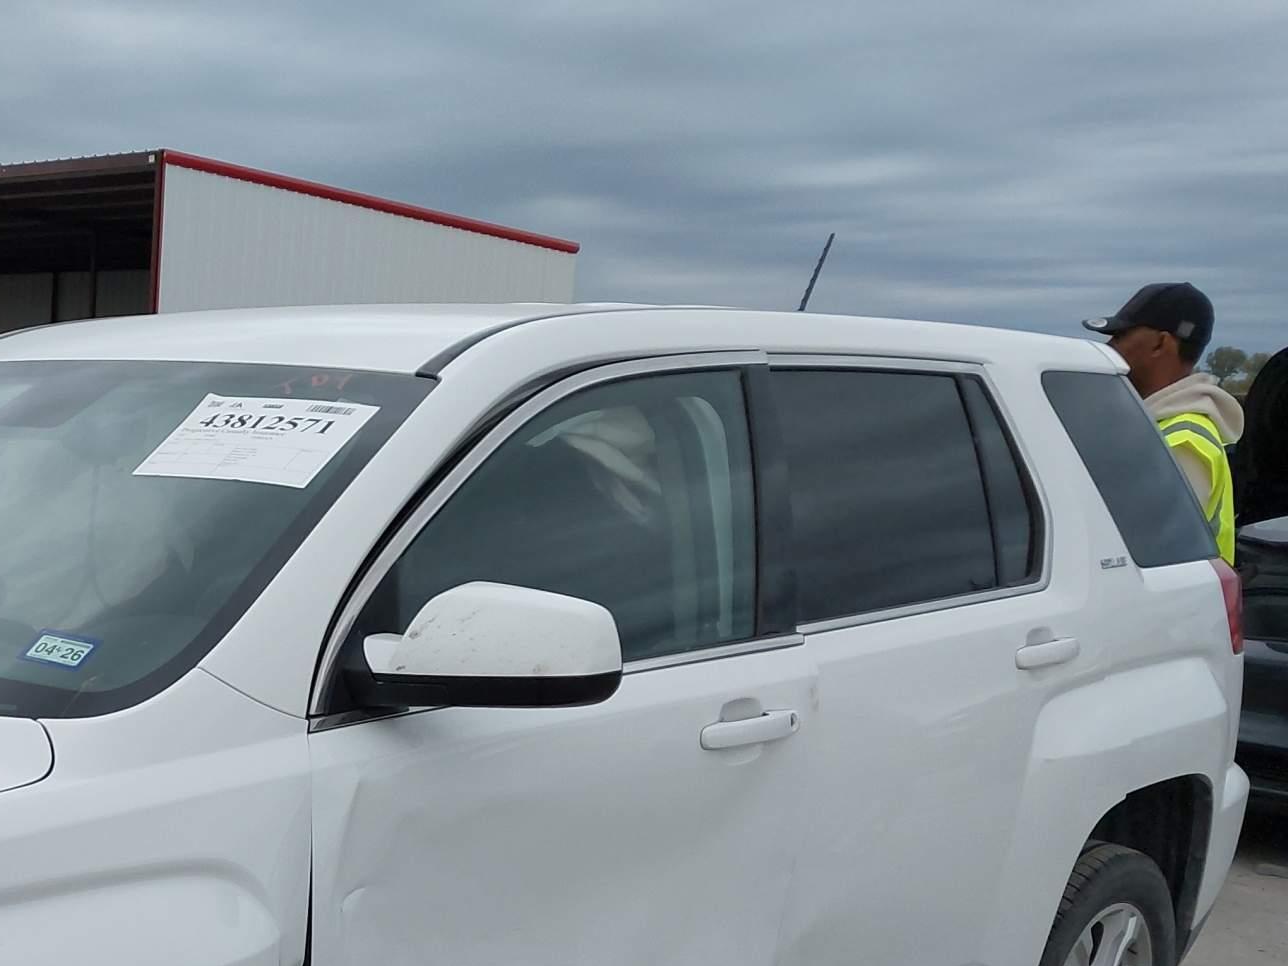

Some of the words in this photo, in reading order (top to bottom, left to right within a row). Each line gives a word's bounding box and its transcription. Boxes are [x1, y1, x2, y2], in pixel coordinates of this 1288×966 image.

[199, 412, 336, 435] 43812571
[34, 642, 58, 655] 04
[59, 647, 85, 661] 26
